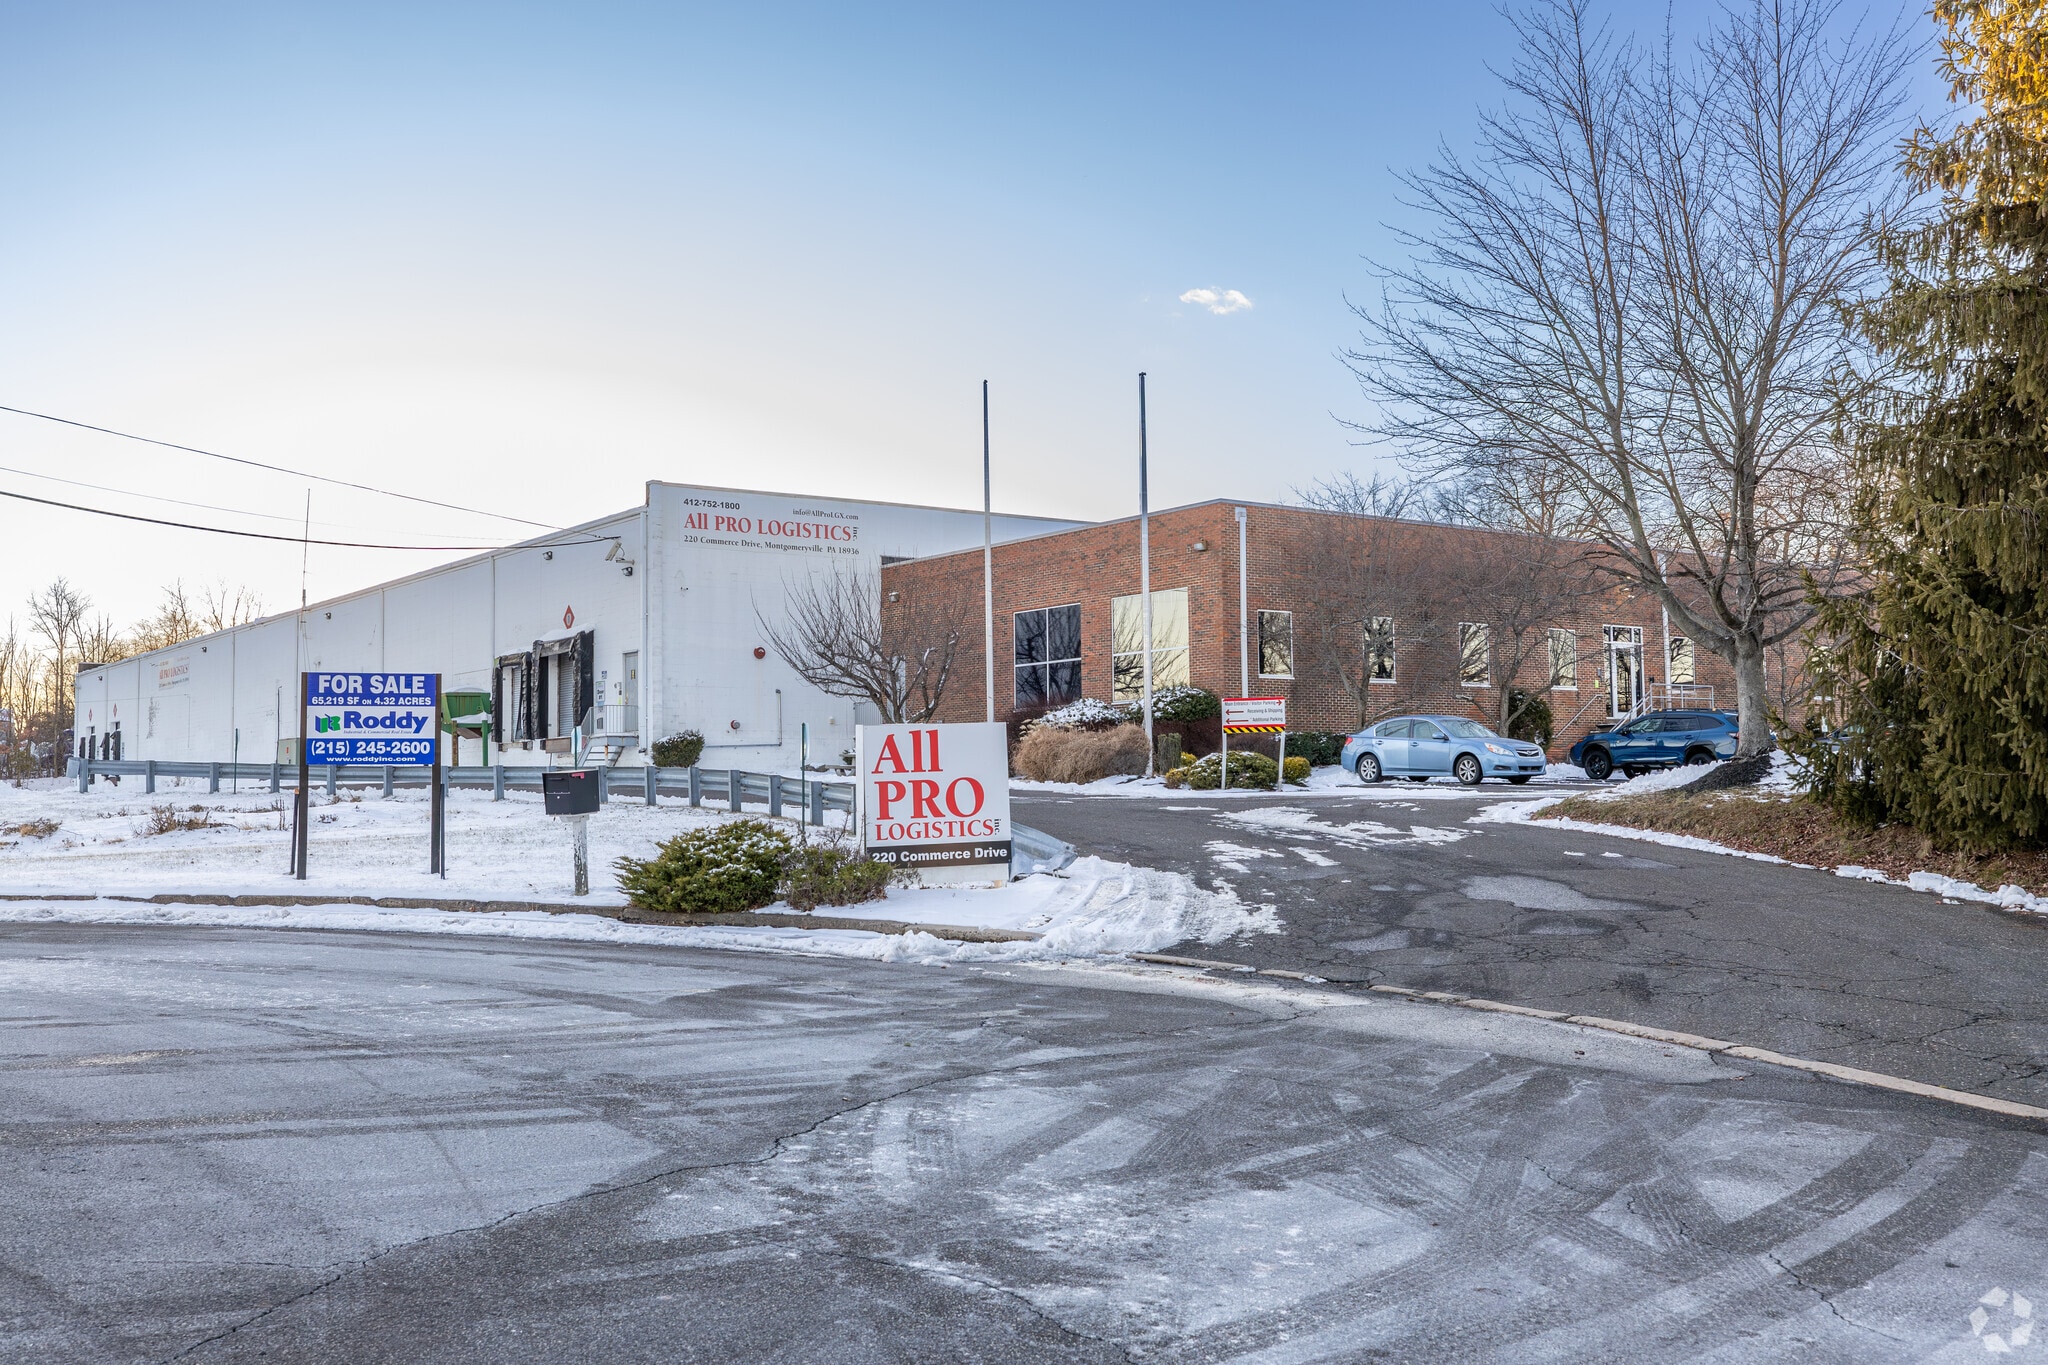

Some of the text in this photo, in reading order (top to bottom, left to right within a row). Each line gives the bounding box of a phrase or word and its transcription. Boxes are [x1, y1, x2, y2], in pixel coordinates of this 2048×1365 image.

[684, 498, 740, 510] 412-752-1800
[792, 508, 859, 520] info@AllProLGX.com
[684, 512, 708, 530] All
[714, 515, 752, 534] PRO
[758, 518, 852, 542] LOGISTICS
[684, 534, 860, 555] 220 Commerce Drive, Montgomeryville PA 18936
[318, 674, 425, 694] FOR SALE
[312, 696, 344, 706] 65,219
[347, 696, 360, 705] SF
[374, 697, 396, 705] 4.32
[398, 697, 432, 705] ACRES
[343, 711, 429, 734] Roddy
[311, 740, 430, 756] (215) 245-2600
[871, 729, 943, 774] All
[874, 776, 985, 820] PRO
[875, 819, 994, 841] LOGISTICS
[872, 847, 1008, 863] 220 Commerce Drive
